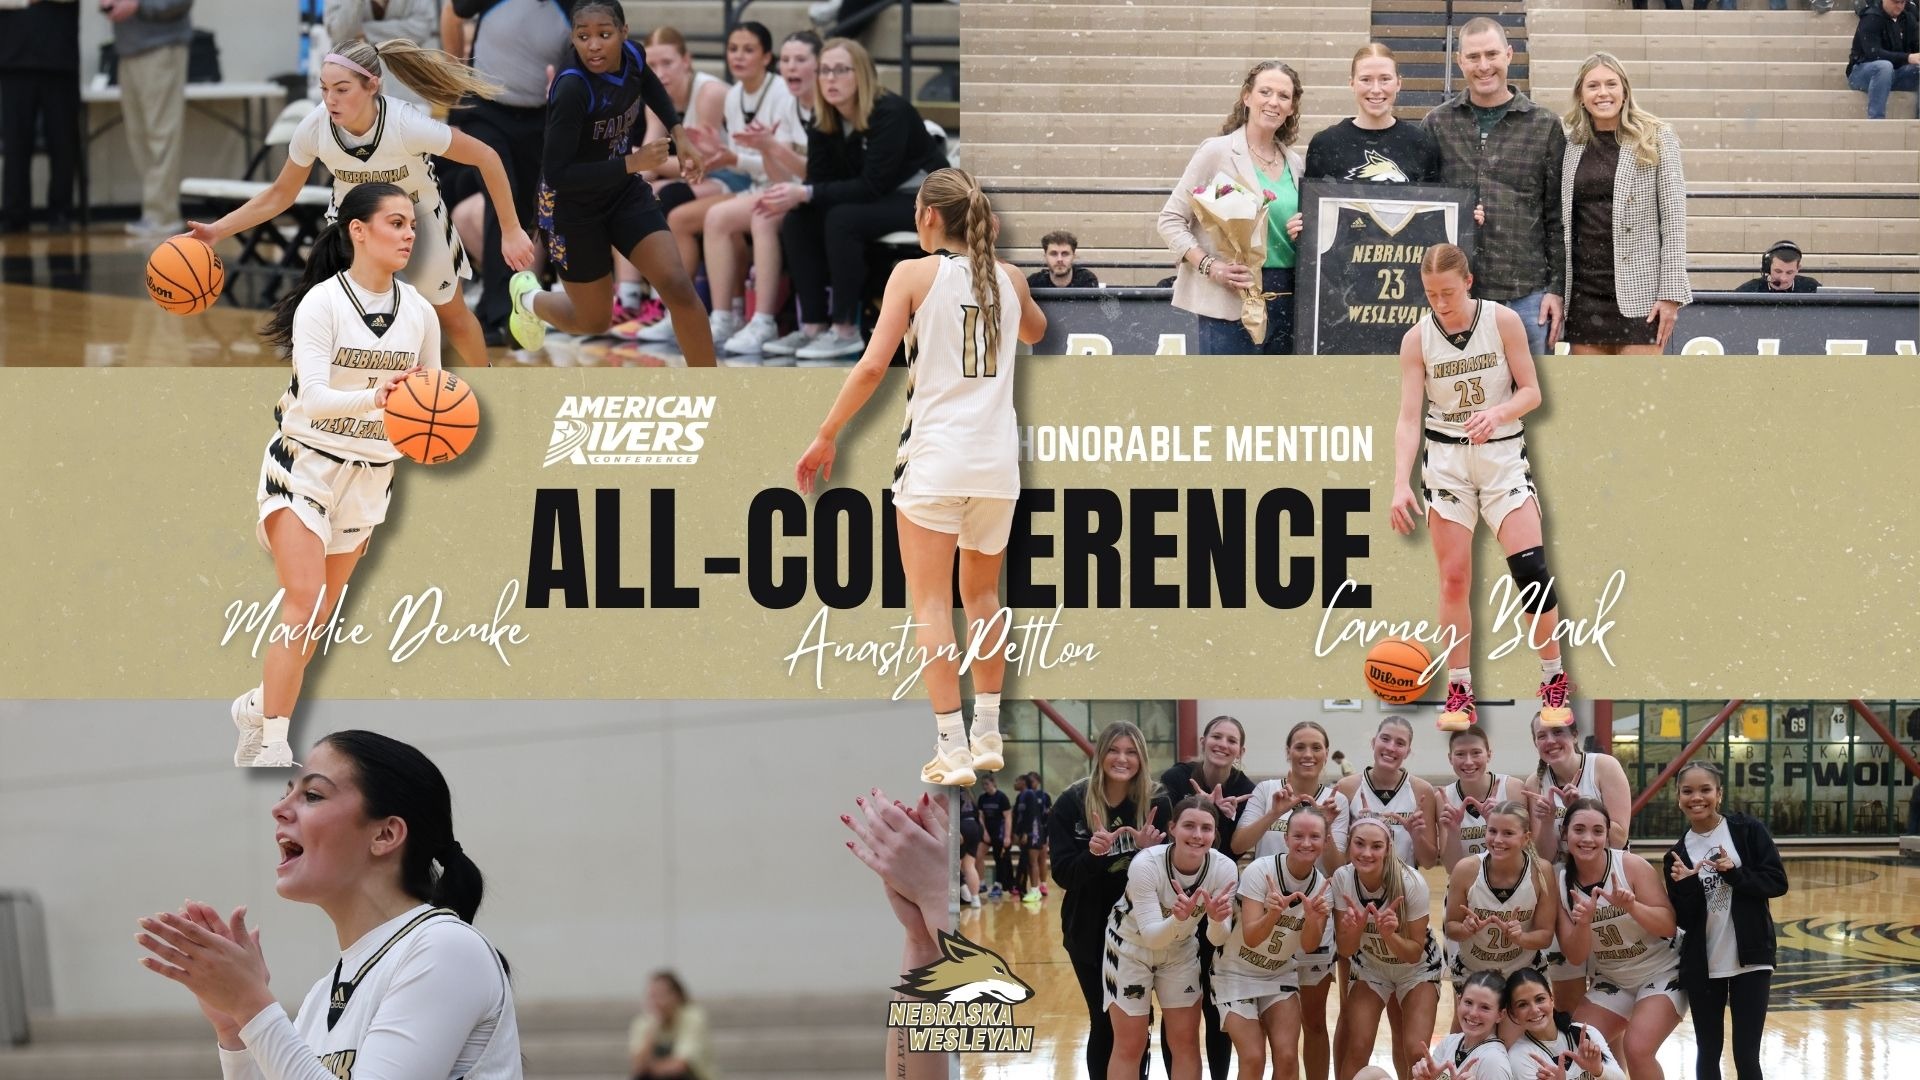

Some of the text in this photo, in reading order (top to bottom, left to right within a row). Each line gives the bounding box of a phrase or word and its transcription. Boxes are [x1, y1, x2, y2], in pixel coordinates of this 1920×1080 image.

[334, 164, 410, 184] NEBRASKA
[1351, 244, 1429, 264] NEBRASK
[1377, 268, 1406, 300] 23
[960, 304, 998, 378] 11
[1432, 352, 1499, 379] NEBRASKA
[1454, 376, 1486, 408] 23
[1369, 664, 1414, 688] Wilson
[1373, 689, 1407, 702] NCAA
[1790, 718, 1806, 732] 69
[1833, 714, 1845, 724] 42
[1707, 745, 1848, 759] NEBASKA
[1735, 762, 1774, 787] IS
[1268, 931, 1286, 954] 5
[1592, 924, 1624, 947] 30
